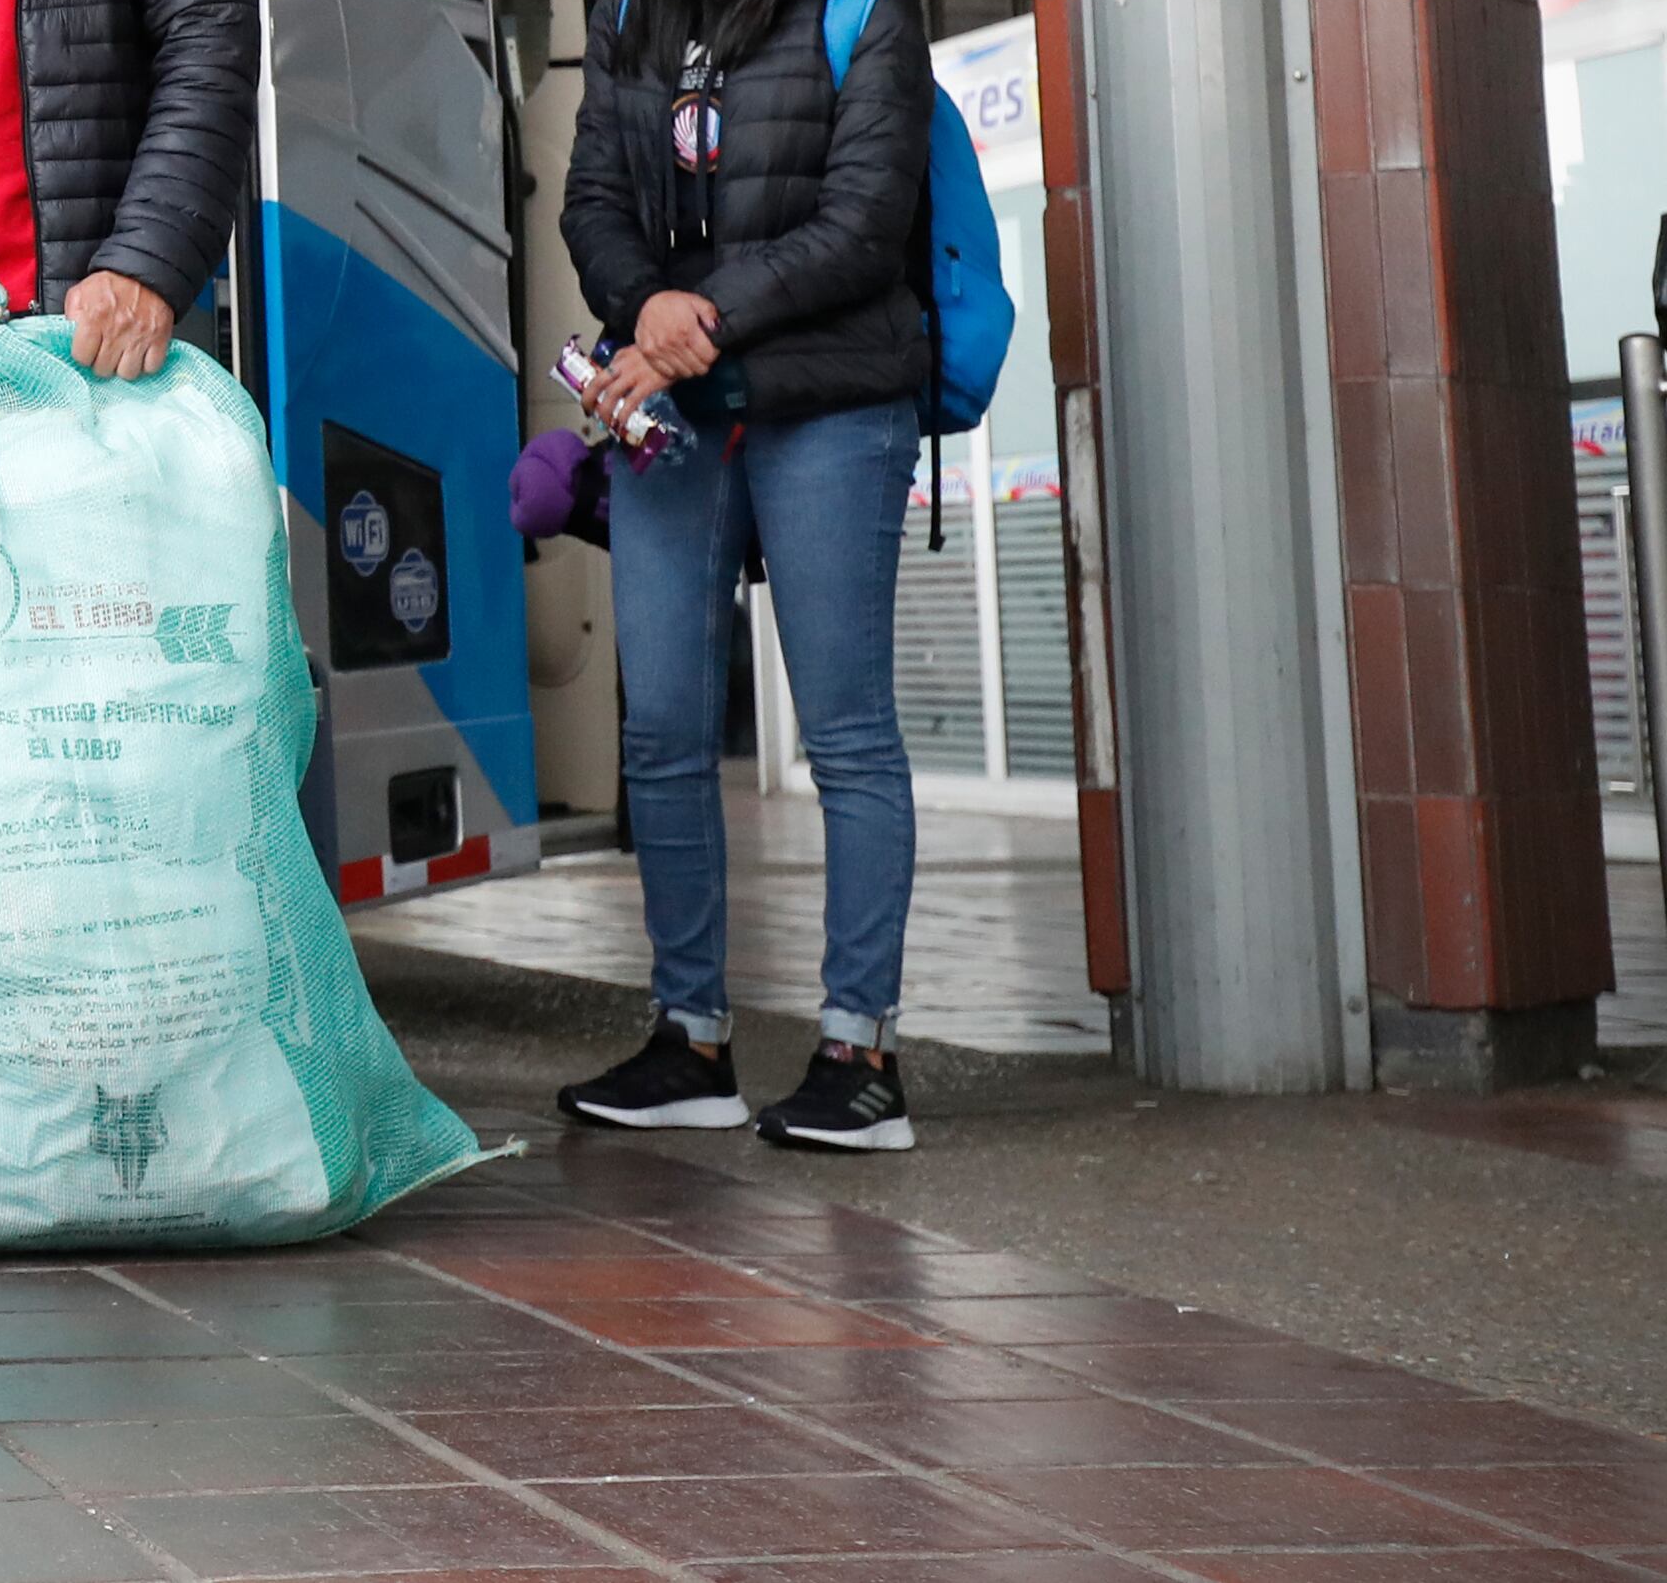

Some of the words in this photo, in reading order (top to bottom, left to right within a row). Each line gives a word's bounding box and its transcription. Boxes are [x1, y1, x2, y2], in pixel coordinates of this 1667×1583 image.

[29, 604, 65, 630] EL
[73, 600, 154, 629] LOBO
[27, 736, 56, 760] EL
[61, 737, 123, 760] LOBO
